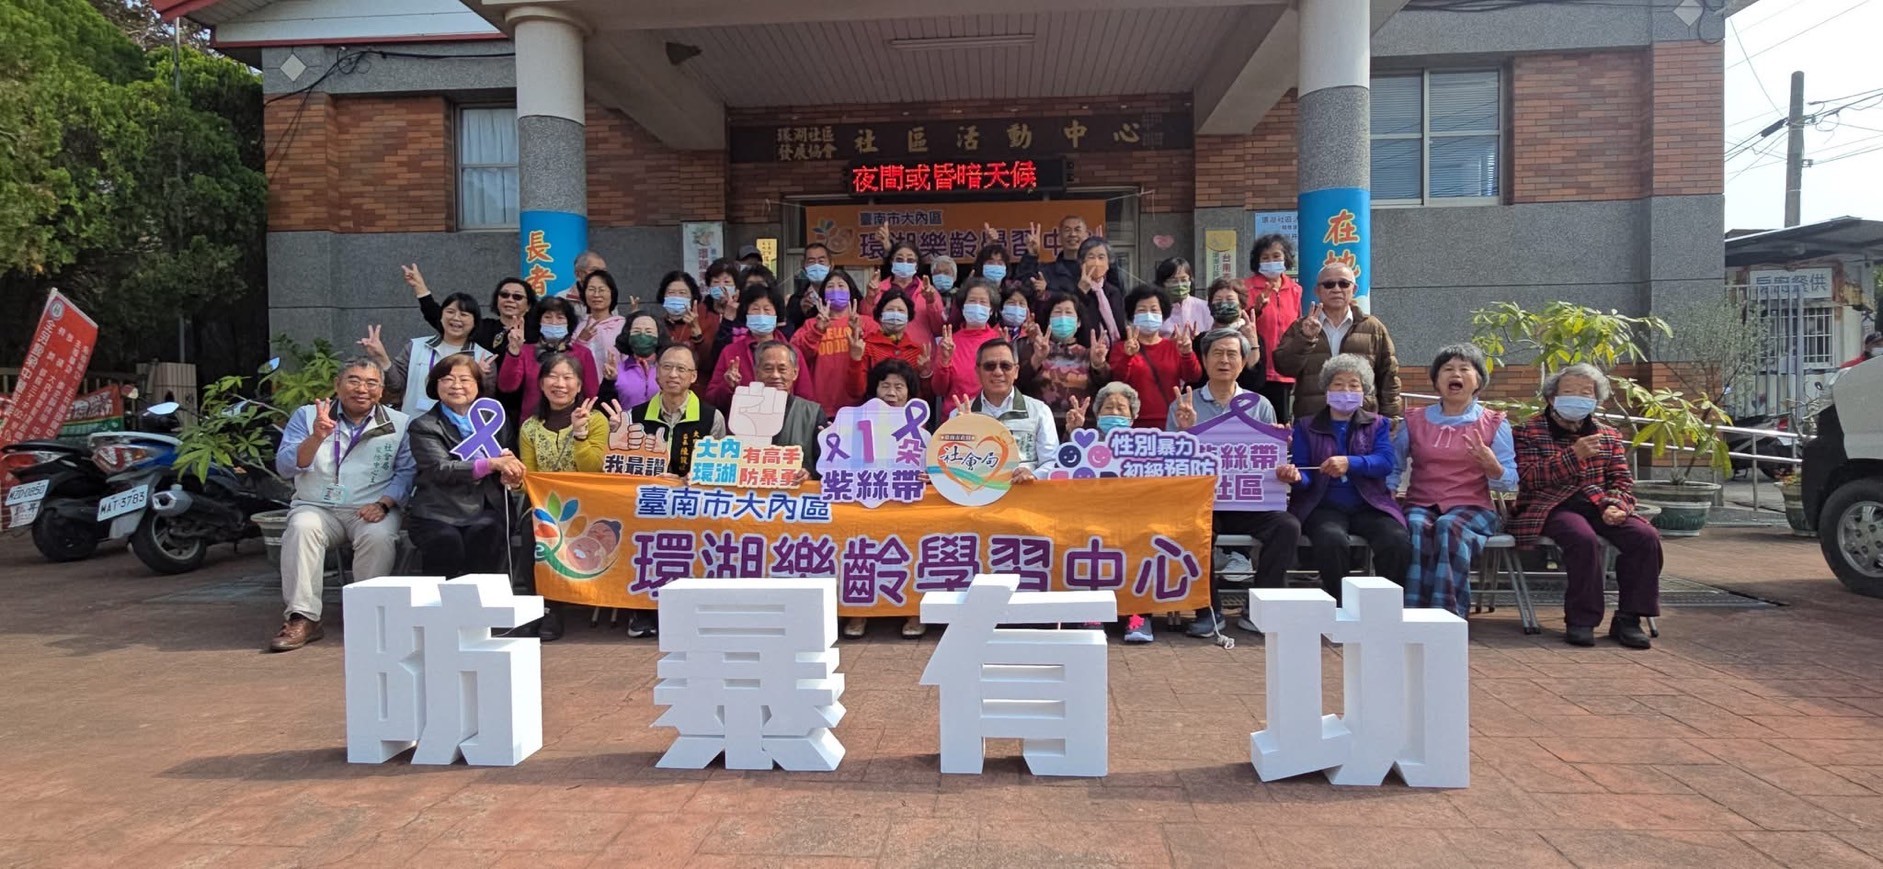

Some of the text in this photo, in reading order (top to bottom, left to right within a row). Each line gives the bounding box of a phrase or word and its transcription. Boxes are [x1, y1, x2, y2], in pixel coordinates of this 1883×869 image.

[777, 126, 836, 143] 環湖社區
[854, 119, 1141, 154] 社區活動中心
[778, 144, 838, 161] 發展協會
[852, 160, 1037, 193] 夜間或昏暗天候
[859, 210, 943, 226] 臺南市大內區
[525, 230, 556, 297] 長者
[696, 438, 741, 459] 大內
[743, 447, 800, 465] 有高手
[896, 438, 923, 466] 朵
[940, 445, 999, 471] 社會局
[1111, 434, 1193, 457] 性別暴力
[604, 454, 666, 477] 我最讚
[692, 462, 799, 487] 環湖 防暴勇
[1123, 459, 1216, 478] 初級預防
[822, 470, 924, 501] 紫絲帶
[99, 490, 145, 515] MAT-3783
[637, 486, 830, 521] 臺南市大內區
[629, 532, 1200, 604] 環湖樂齡學習中心
